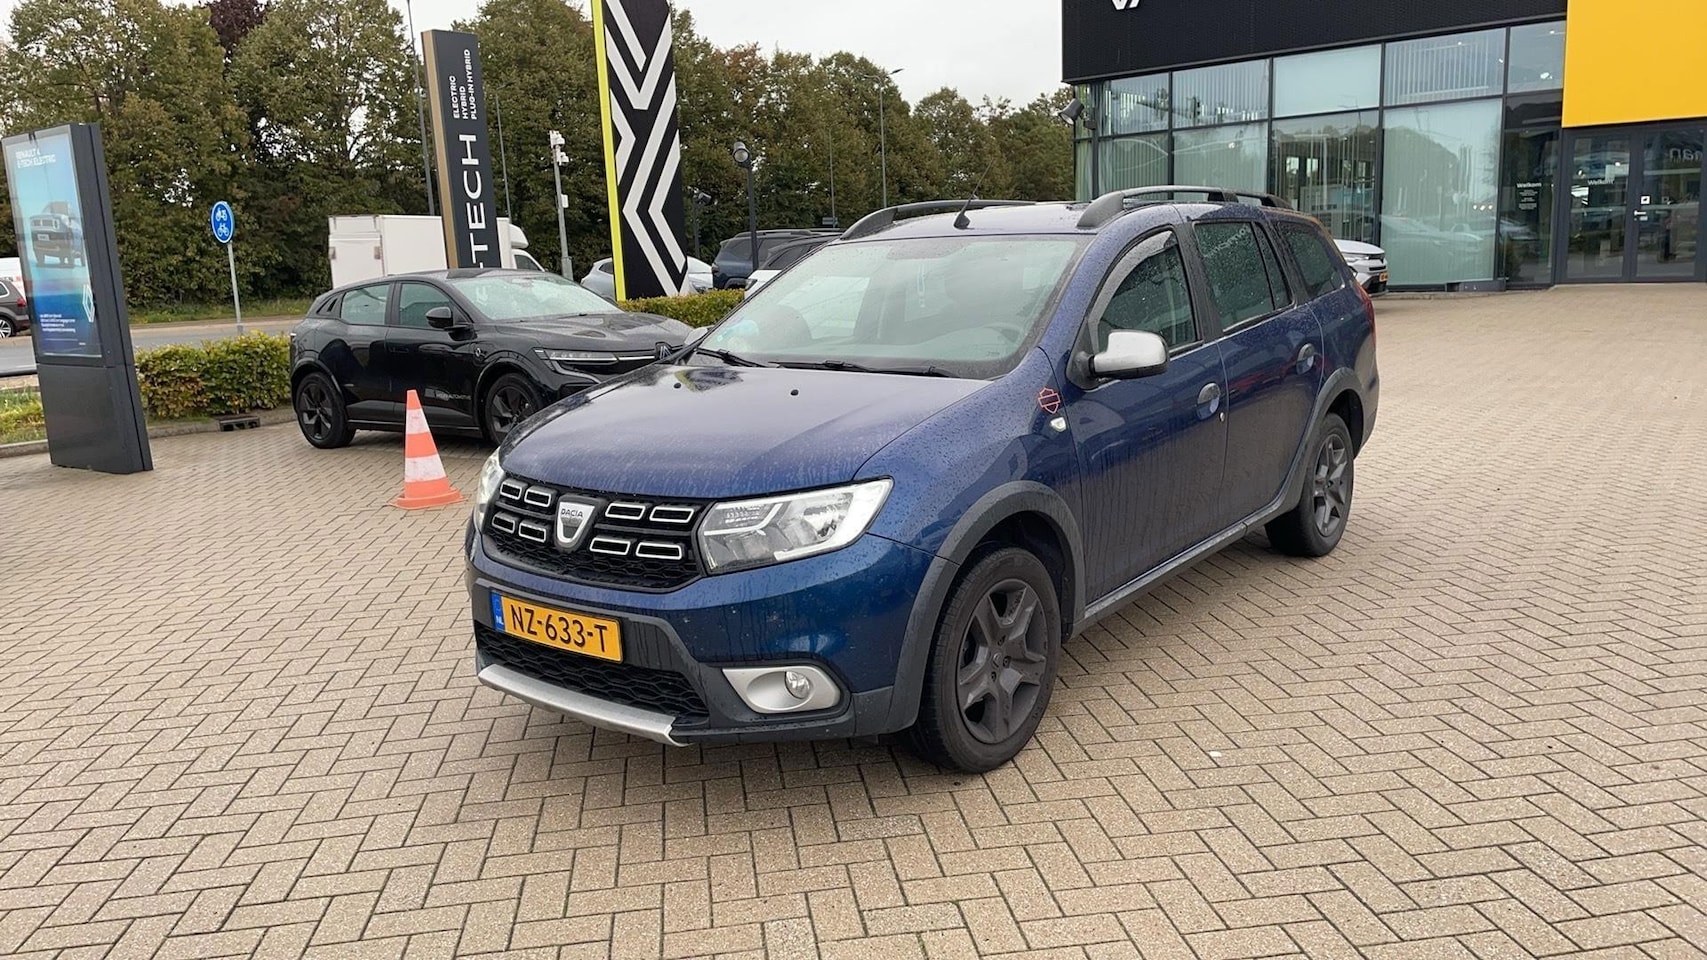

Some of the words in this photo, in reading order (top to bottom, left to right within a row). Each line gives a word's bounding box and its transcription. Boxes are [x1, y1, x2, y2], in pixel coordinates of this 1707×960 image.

[464, 49, 474, 83] HYBRID
[449, 75, 460, 119] ELECTRIC
[459, 86, 469, 120] HYBRID
[468, 83, 477, 120] PLUG-IN
[561, 508, 583, 518] DACIA
[495, 614, 505, 626] NL
[510, 604, 608, 653] NZ-633-T
